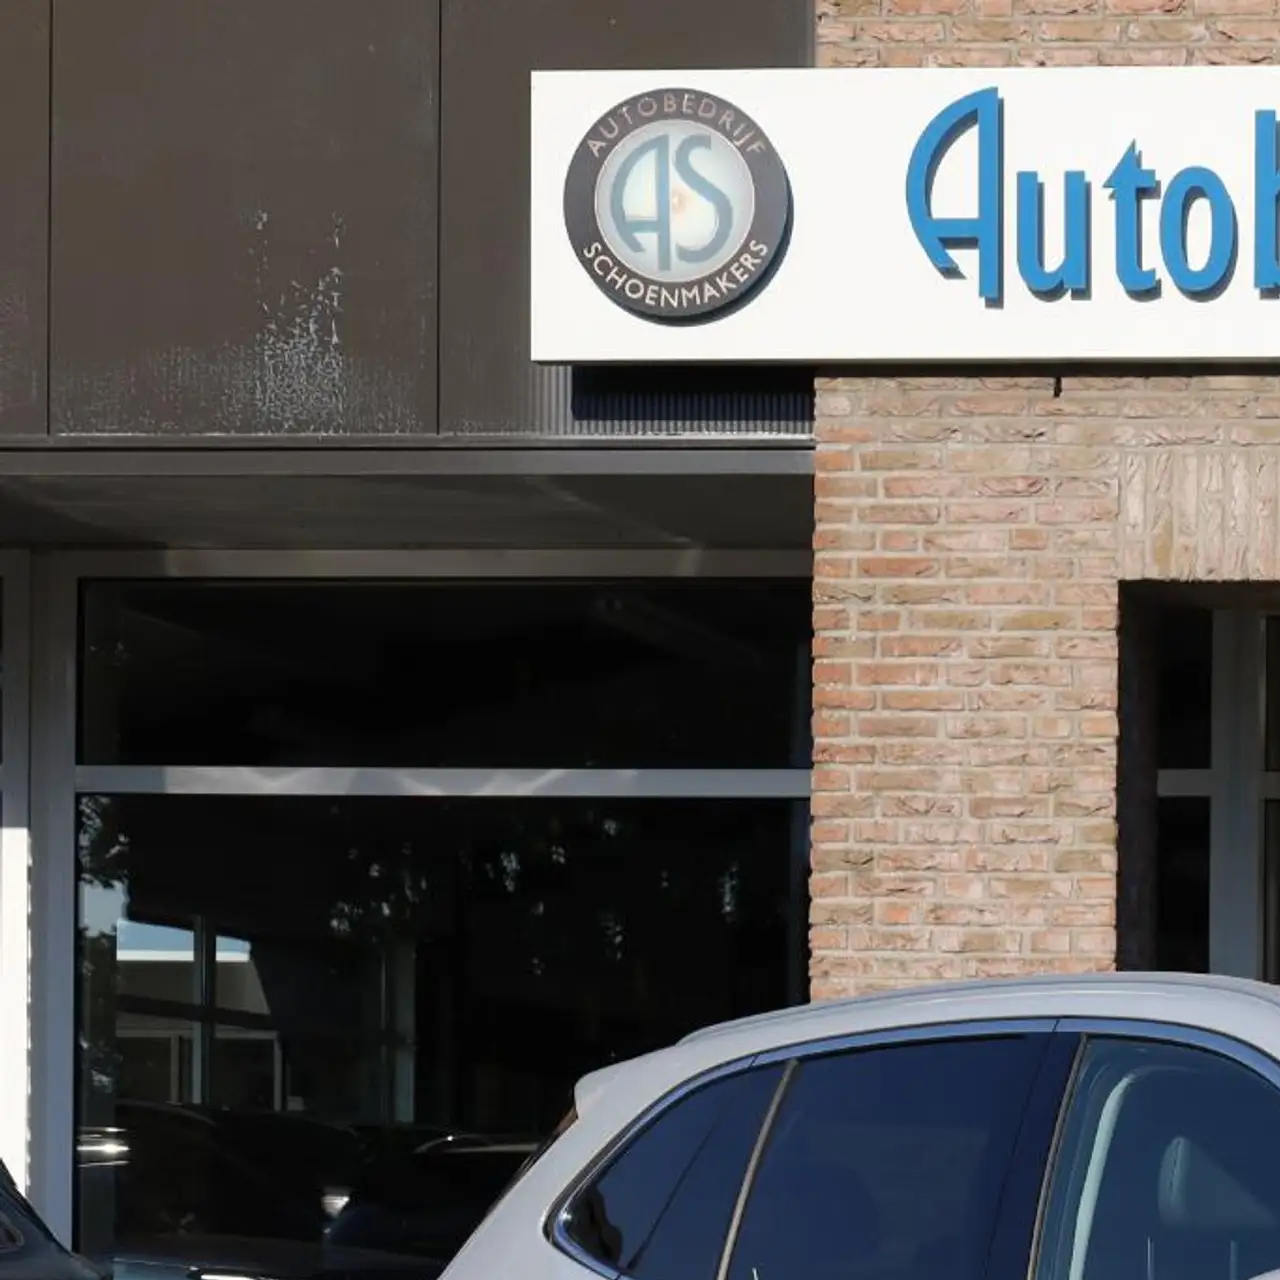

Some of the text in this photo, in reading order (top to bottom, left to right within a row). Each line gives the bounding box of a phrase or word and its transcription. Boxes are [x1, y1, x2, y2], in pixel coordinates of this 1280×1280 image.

[587, 93, 766, 158] AUTOBEDRIJF
[610, 133, 734, 271] AS
[583, 239, 768, 308] SCHOENMAKERS
